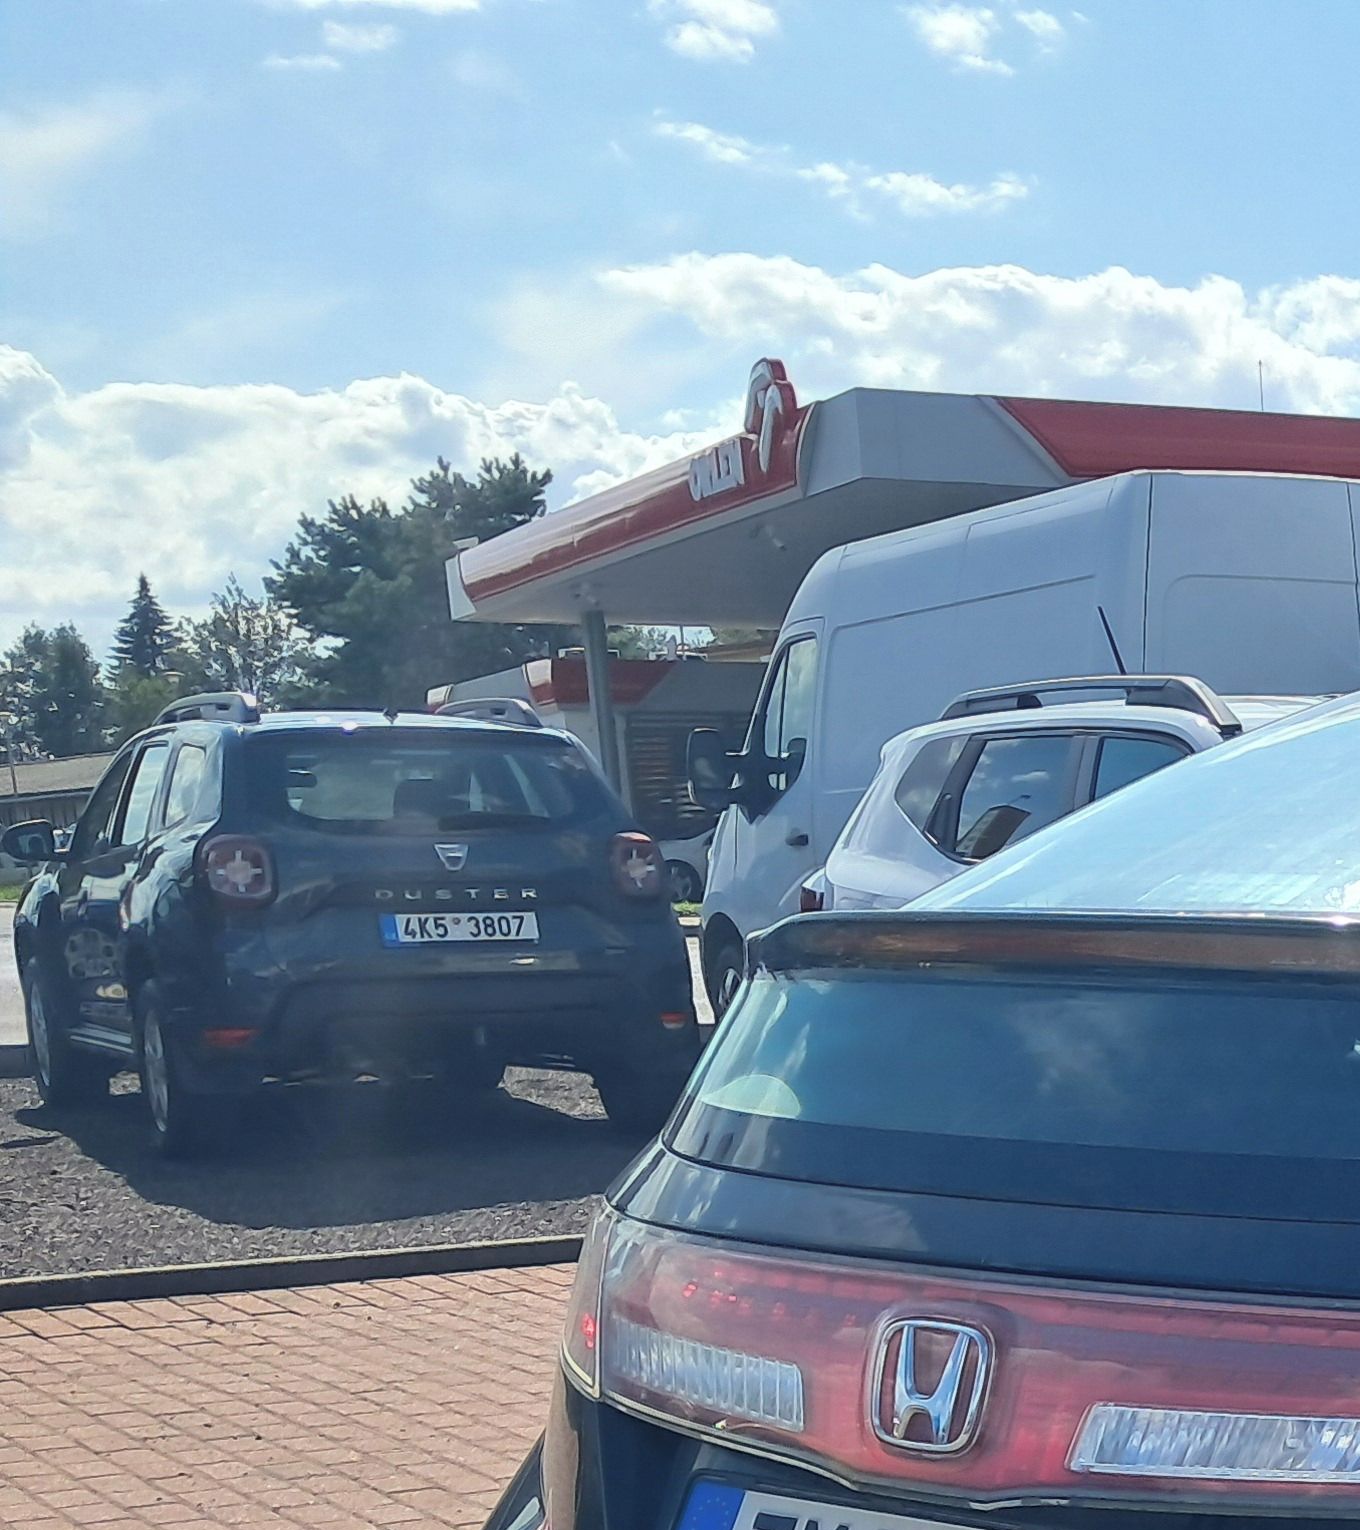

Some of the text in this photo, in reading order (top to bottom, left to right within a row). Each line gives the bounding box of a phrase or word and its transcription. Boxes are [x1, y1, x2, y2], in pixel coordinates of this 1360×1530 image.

[374, 888, 538, 900] DUSTER
[404, 915, 525, 939] 4K5 3807
